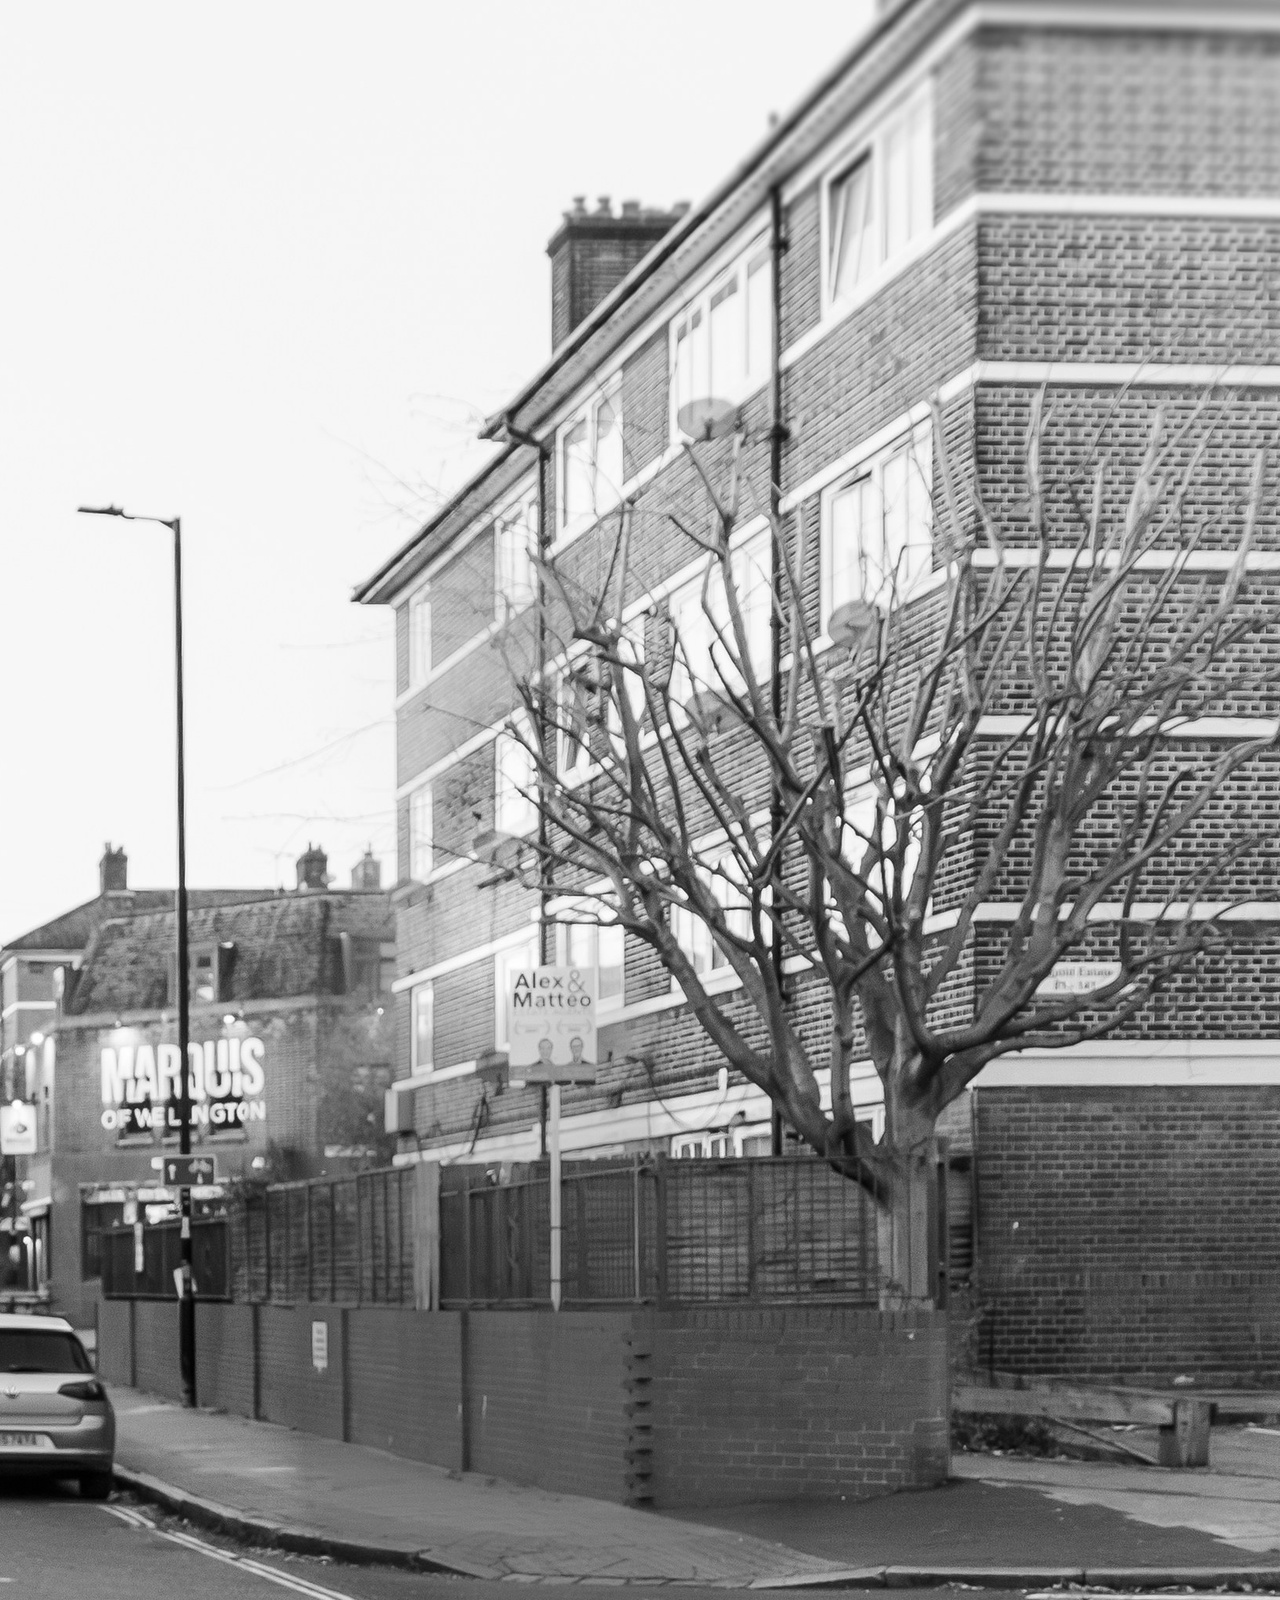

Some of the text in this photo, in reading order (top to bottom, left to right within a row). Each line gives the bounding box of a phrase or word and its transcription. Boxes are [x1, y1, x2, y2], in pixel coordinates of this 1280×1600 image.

[515, 969, 586, 993] Alex &
[513, 992, 591, 1007] Matteo
[101, 1037, 266, 1103] MARQUIS
[101, 1108, 132, 1130] OF
